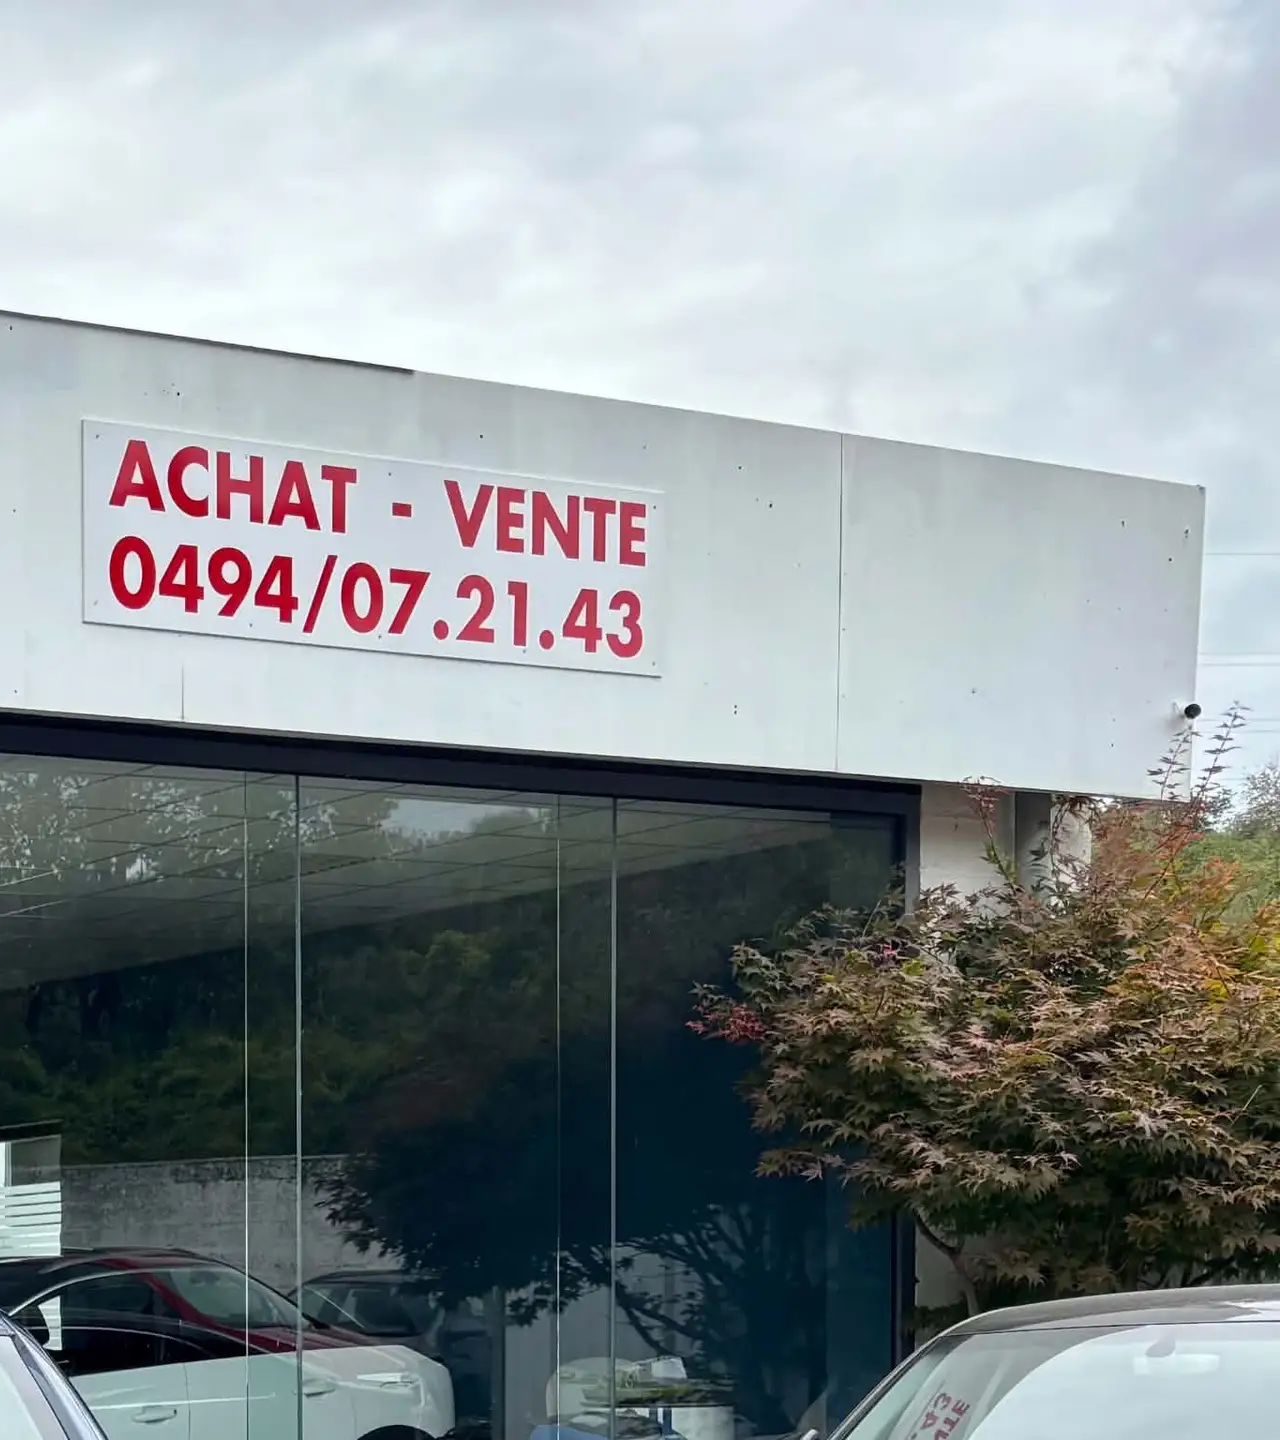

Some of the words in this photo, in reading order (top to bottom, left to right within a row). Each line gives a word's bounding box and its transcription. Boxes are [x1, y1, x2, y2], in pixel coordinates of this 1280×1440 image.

[109, 439, 357, 534] ACHAT
[443, 480, 647, 567] VENTE
[109, 535, 643, 659] 0494/07.21.43
